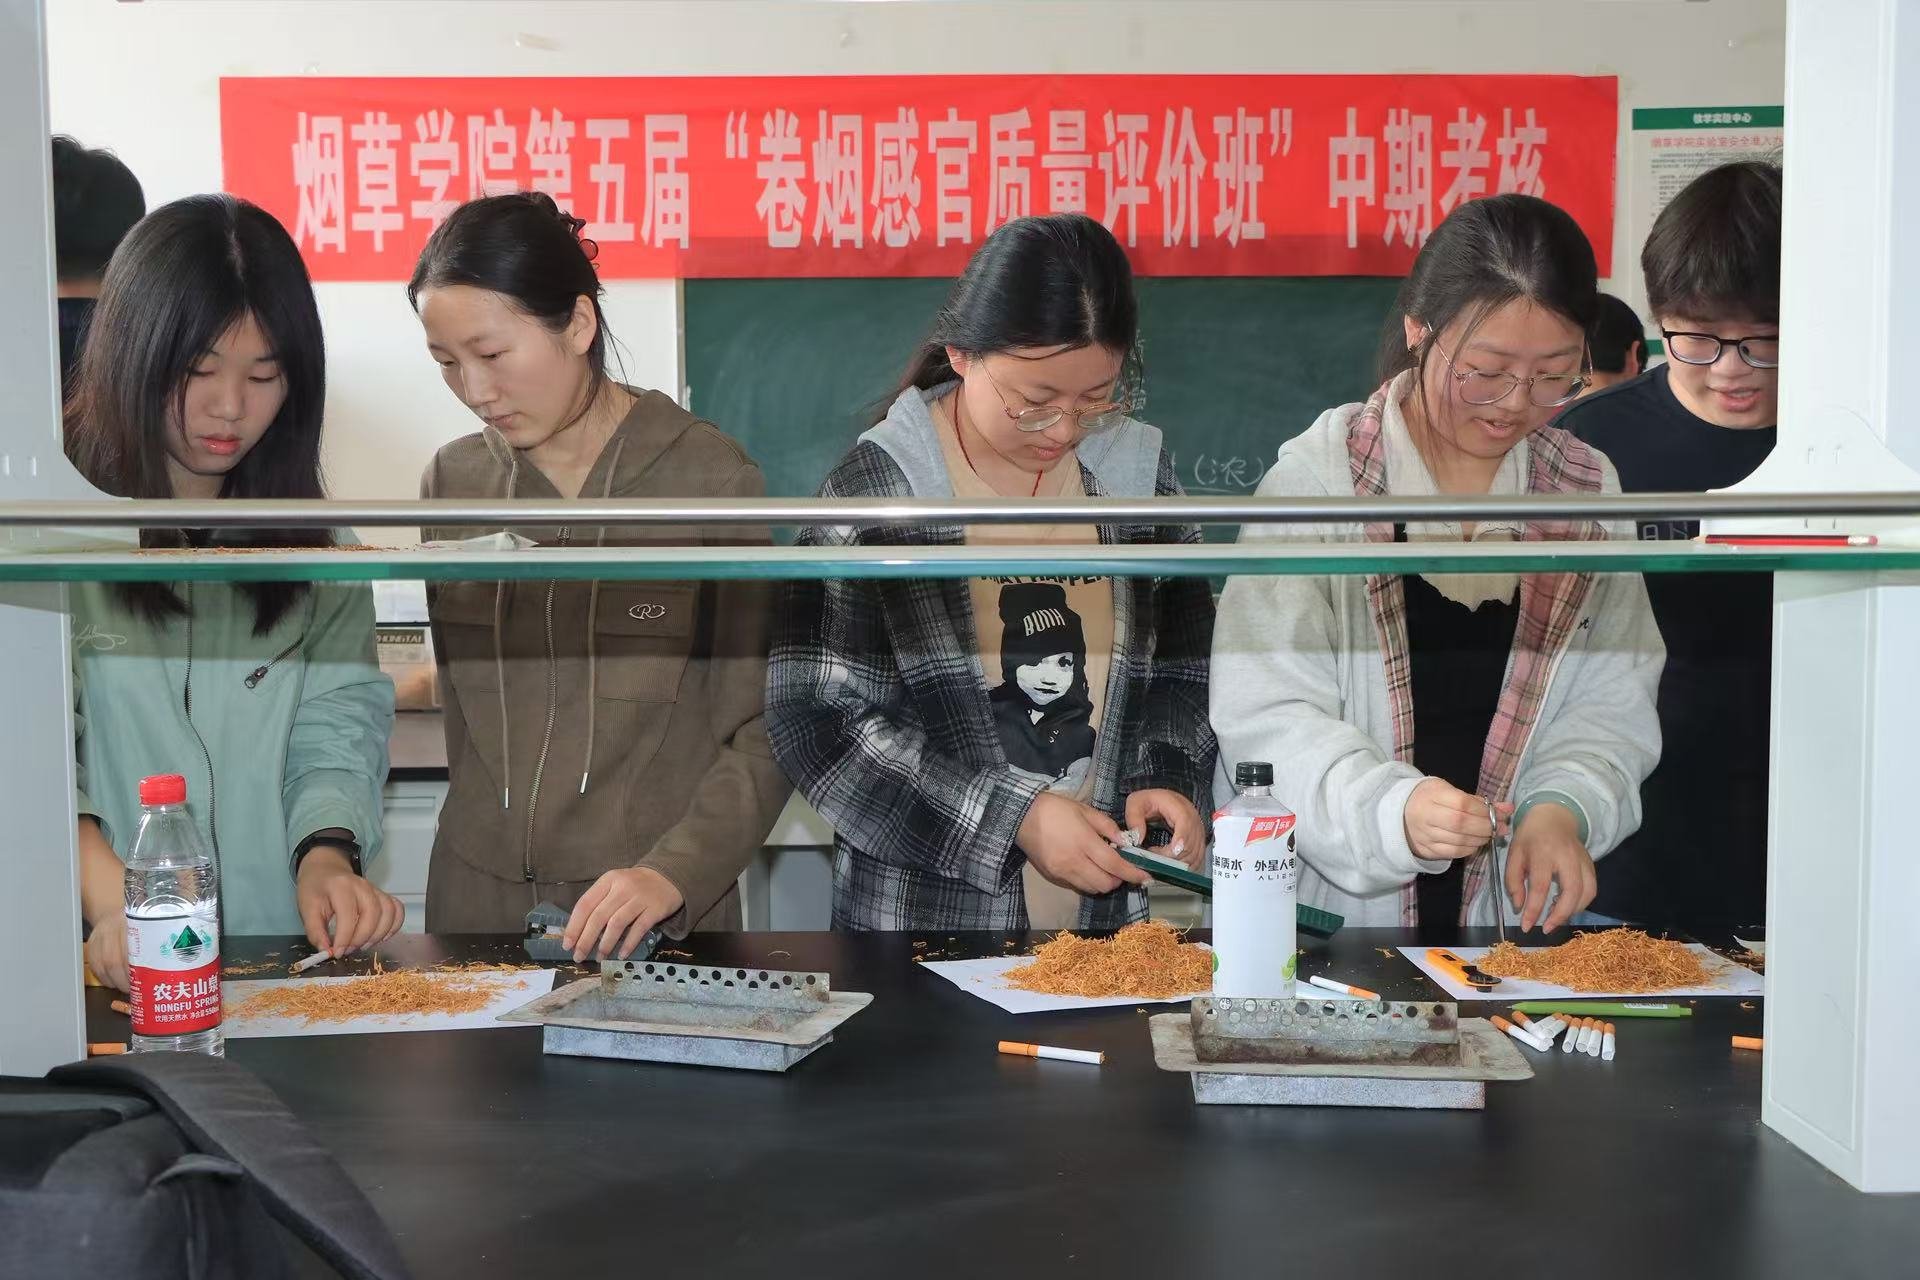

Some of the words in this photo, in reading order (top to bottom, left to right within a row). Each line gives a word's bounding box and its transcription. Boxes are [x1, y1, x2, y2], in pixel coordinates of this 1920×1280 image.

[292, 107, 690, 254] 烟草学院第五届
[1328, 107, 1547, 249] 中期考核
[1213, 854, 1242, 871] 解质水
[153, 974, 219, 1001] 农夫山泉
[154, 1001, 192, 1013] NONGFU
